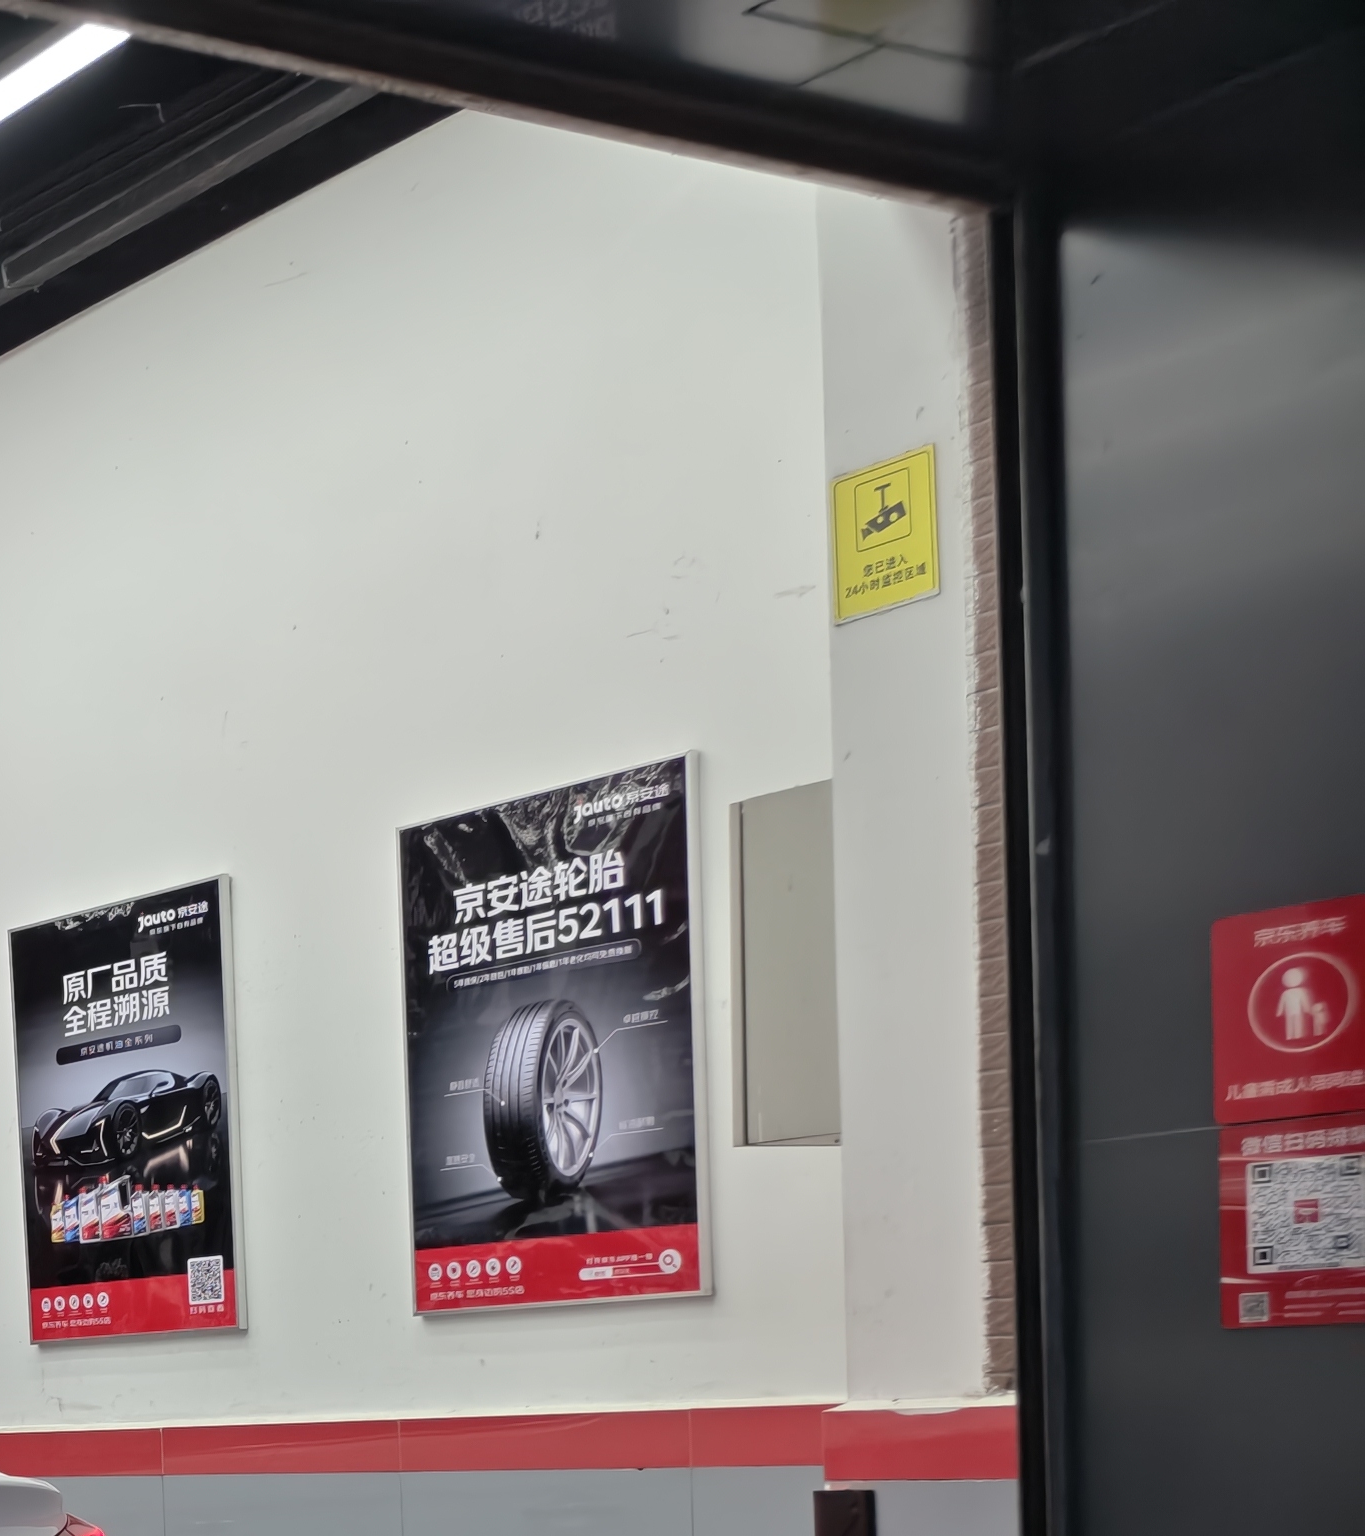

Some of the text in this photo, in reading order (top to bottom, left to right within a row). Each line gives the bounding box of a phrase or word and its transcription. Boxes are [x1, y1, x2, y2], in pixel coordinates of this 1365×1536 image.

[452, 848, 626, 925] 京安途轮胎
[137, 900, 209, 933] jauto 京安途
[427, 888, 665, 976] 超级售后52111
[62, 951, 169, 1005] 原厂品质
[62, 985, 171, 1038] 全程溯源
